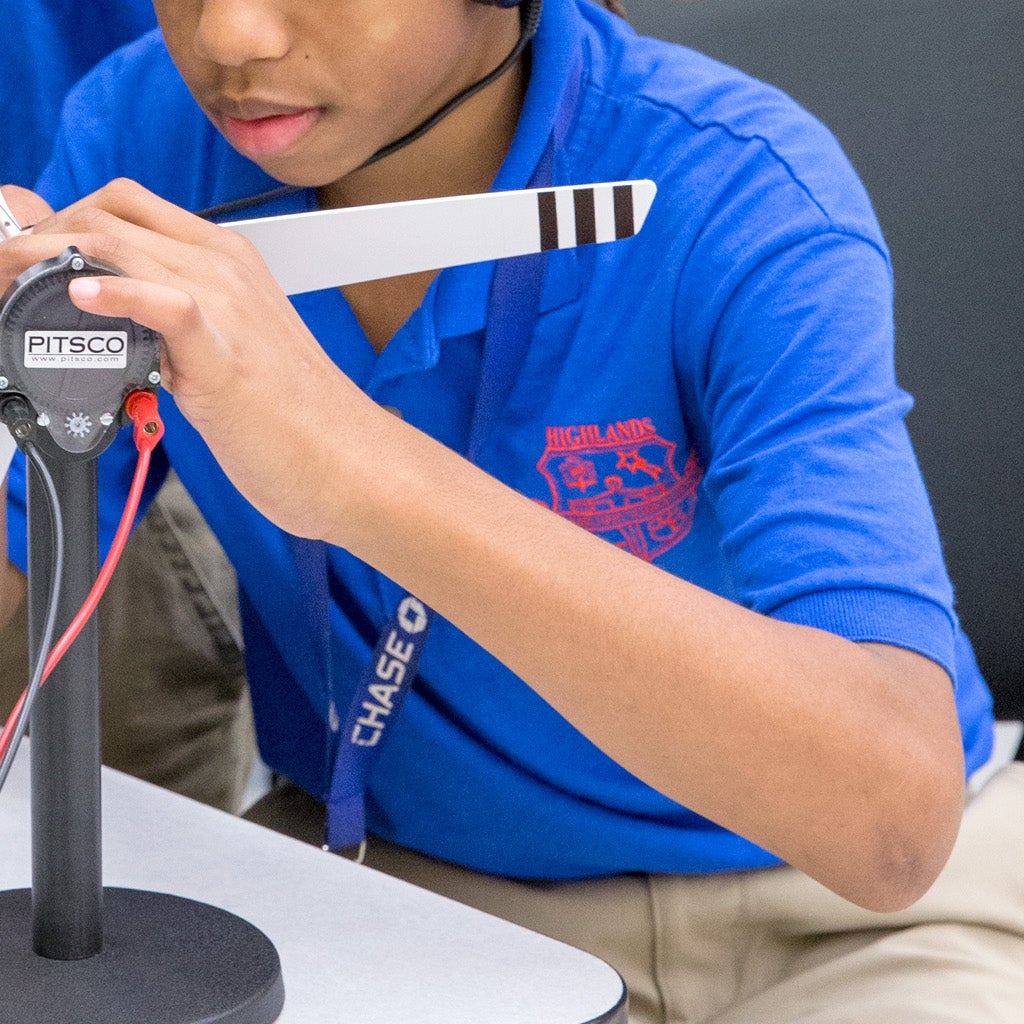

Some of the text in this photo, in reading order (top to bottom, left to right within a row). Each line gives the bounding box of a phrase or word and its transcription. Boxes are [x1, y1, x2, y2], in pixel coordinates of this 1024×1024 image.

[28, 336, 125, 354] PITSCO
[545, 416, 656, 448] HIGHLANDS
[350, 629, 415, 747] CHASE
